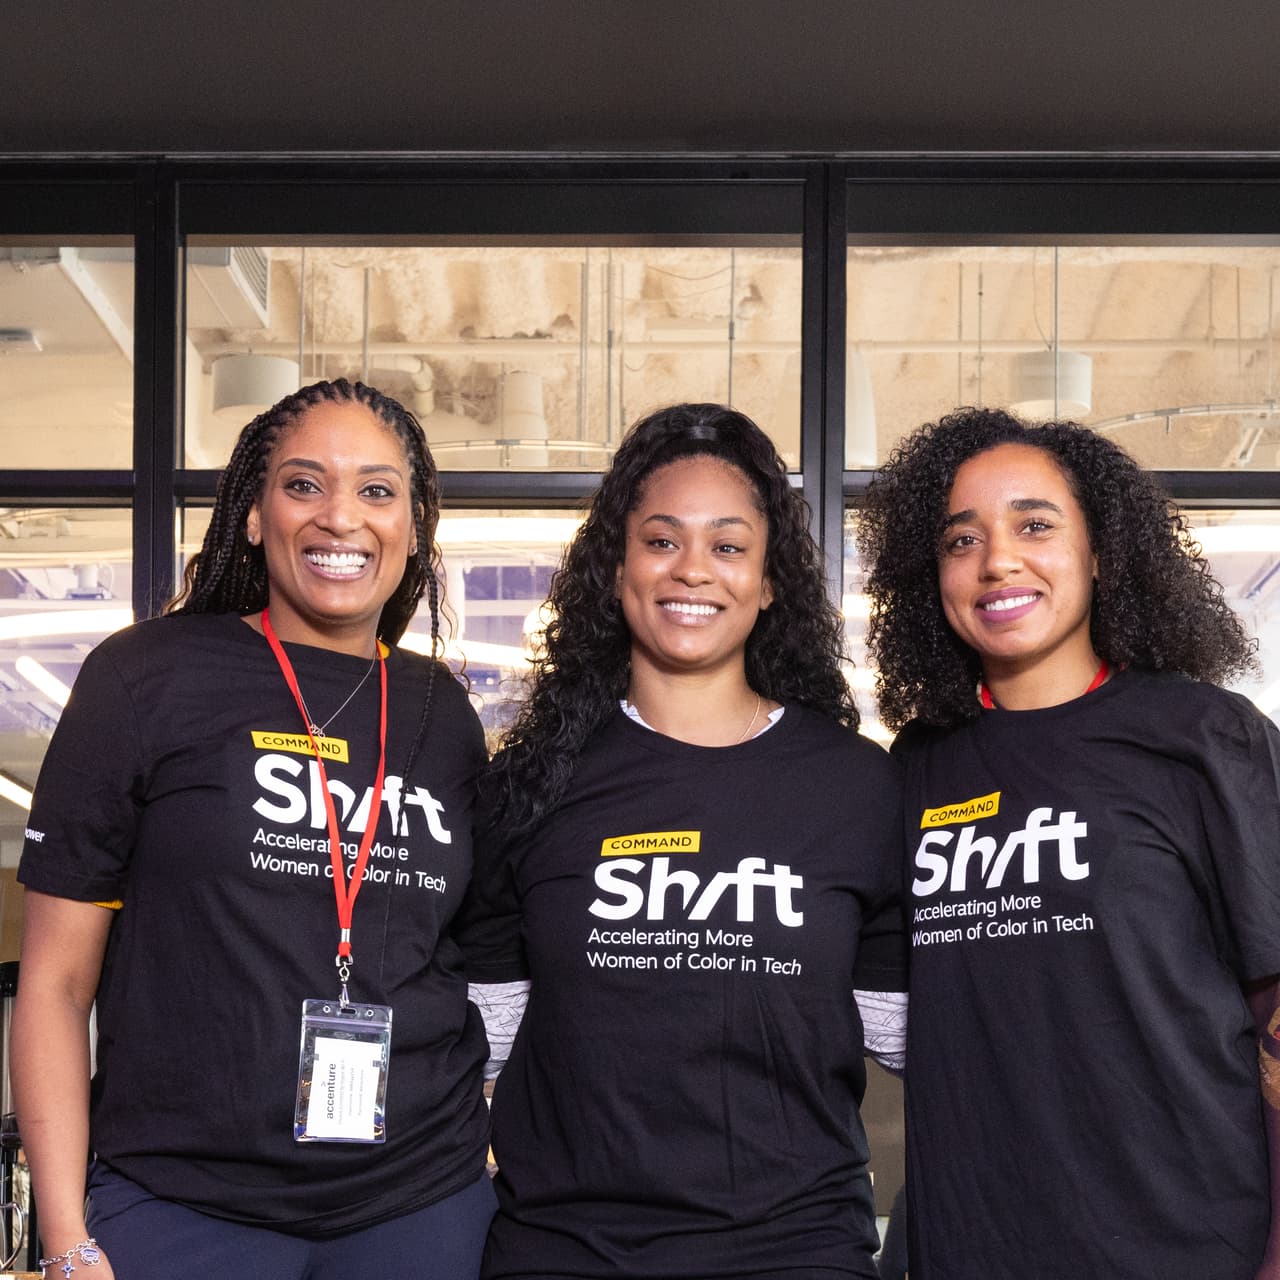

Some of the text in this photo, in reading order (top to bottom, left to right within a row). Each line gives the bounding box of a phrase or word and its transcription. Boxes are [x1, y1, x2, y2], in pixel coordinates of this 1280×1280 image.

[262, 736, 341, 755] COMMAND
[929, 800, 994, 823] COMMAND
[25, 828, 45, 843] ower
[253, 828, 359, 859] Acceleratng
[610, 836, 693, 850] COMMAND
[250, 851, 319, 877] Women
[395, 868, 410, 886] in
[415, 870, 447, 894] Tech
[913, 894, 1042, 924] Accelerating More
[587, 928, 754, 949] Accelerating More
[912, 913, 1094, 947] Women of Color in Tech
[586, 952, 803, 976] Women of Color in Tech
[326, 1063, 336, 1119] accenture
